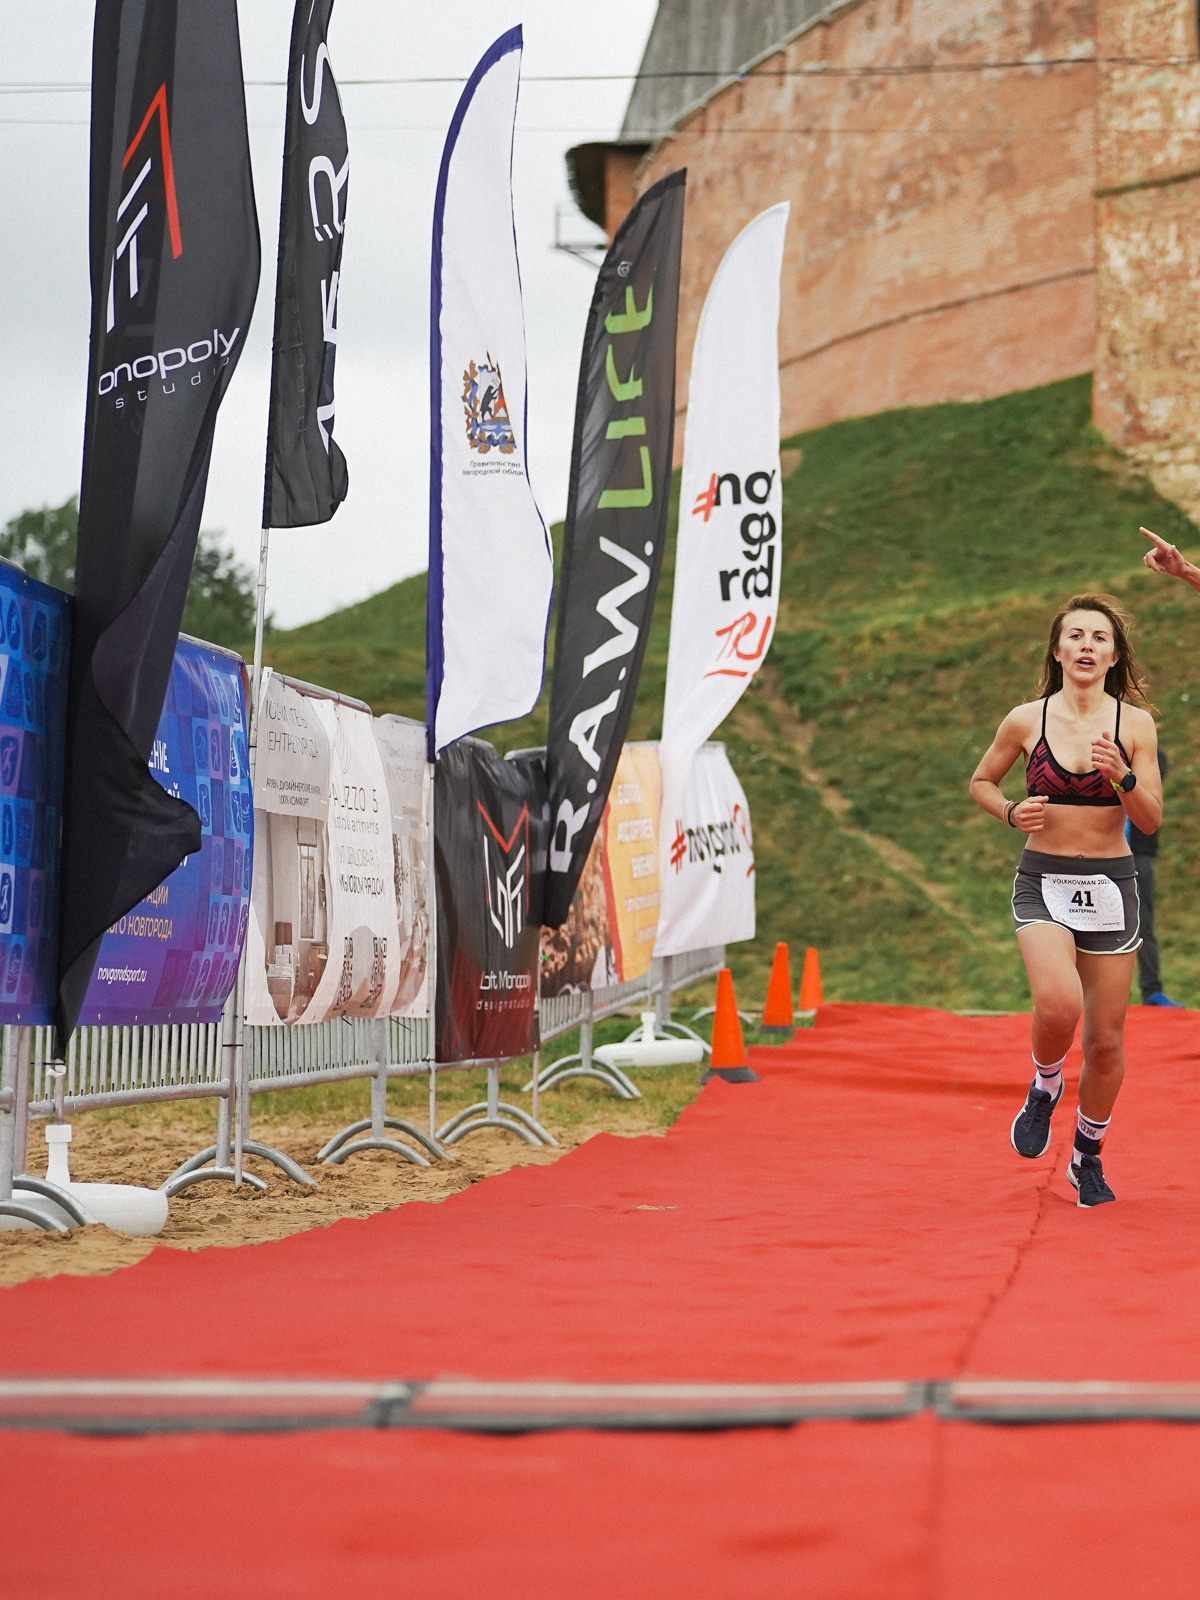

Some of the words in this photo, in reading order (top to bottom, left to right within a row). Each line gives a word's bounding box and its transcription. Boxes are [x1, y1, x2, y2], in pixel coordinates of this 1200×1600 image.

[98, 327, 241, 396] onopoly
[1071, 890, 1095, 907] 41
[127, 915, 173, 942] НОВГОРОДА
